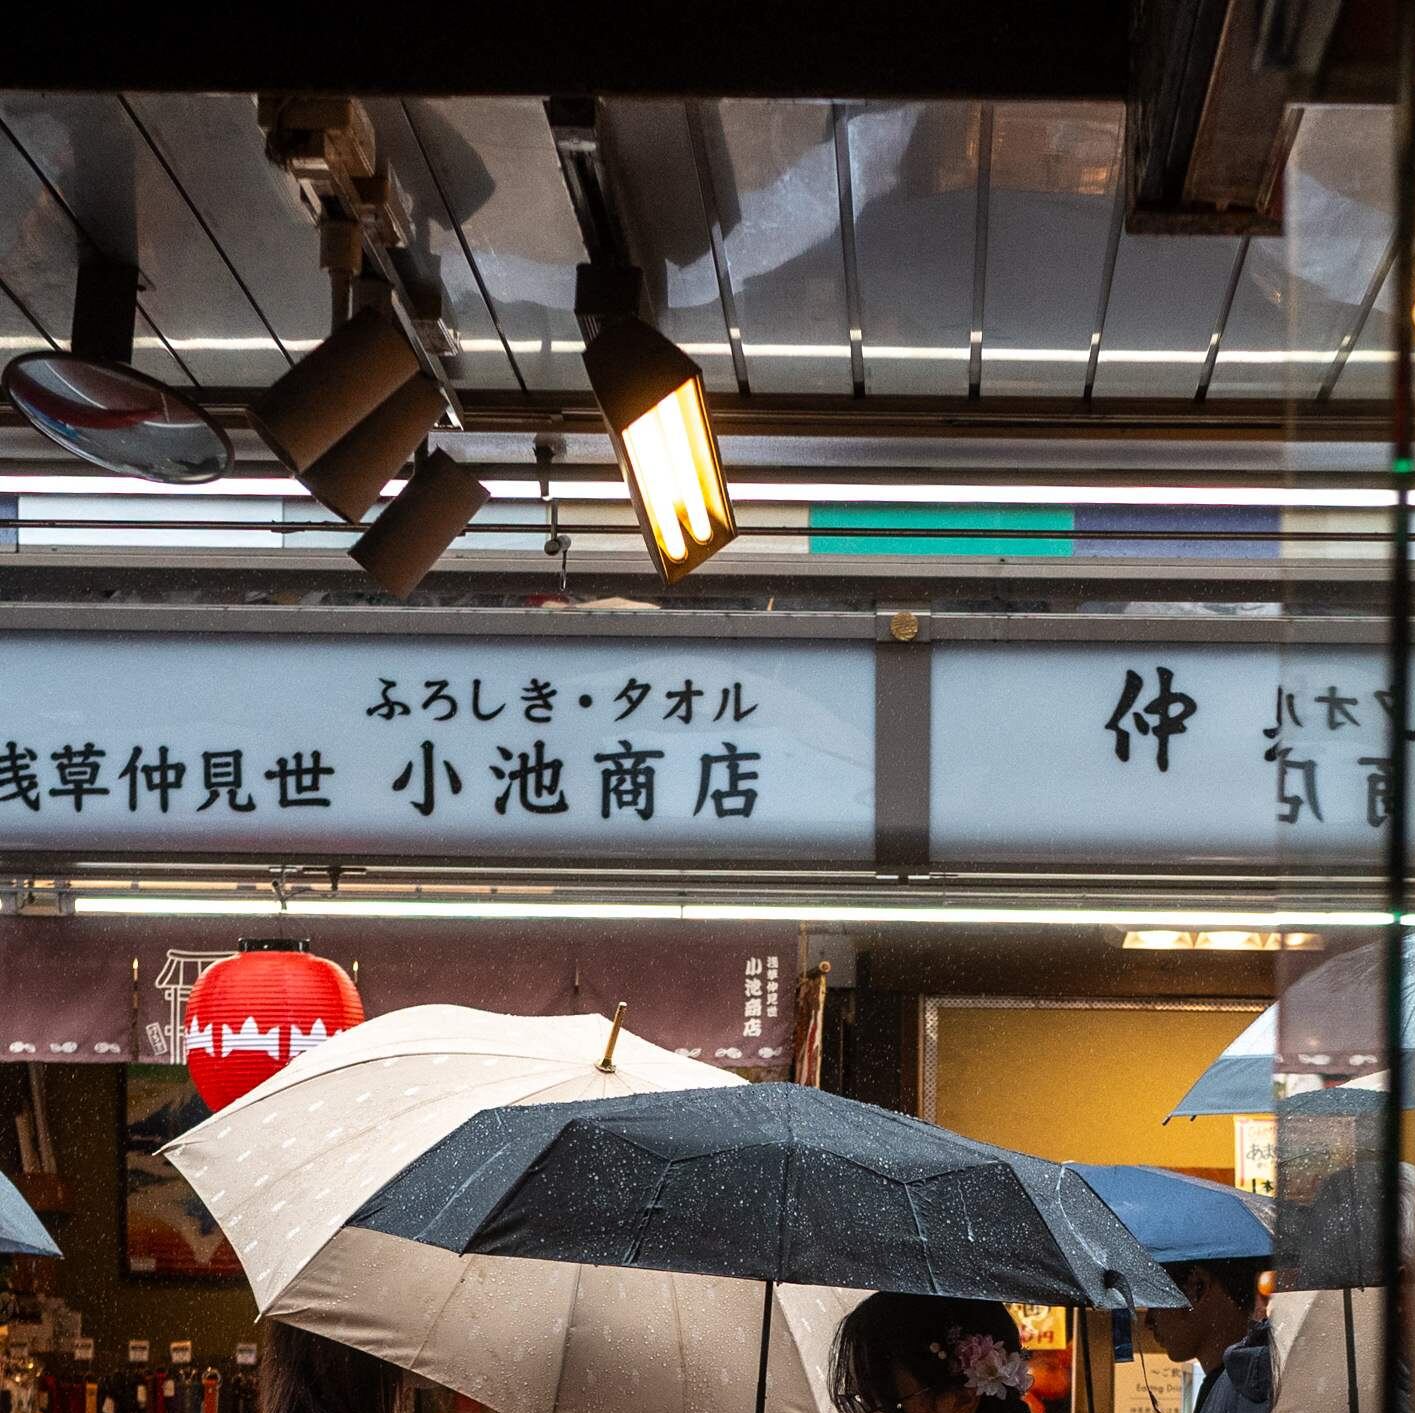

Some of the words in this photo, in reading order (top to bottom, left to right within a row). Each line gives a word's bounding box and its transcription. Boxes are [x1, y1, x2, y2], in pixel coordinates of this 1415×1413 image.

[366, 677, 759, 725] ふろしき・タオル
[391, 739, 762, 821] 小池商店
[743, 956, 763, 1038] 小池商店
